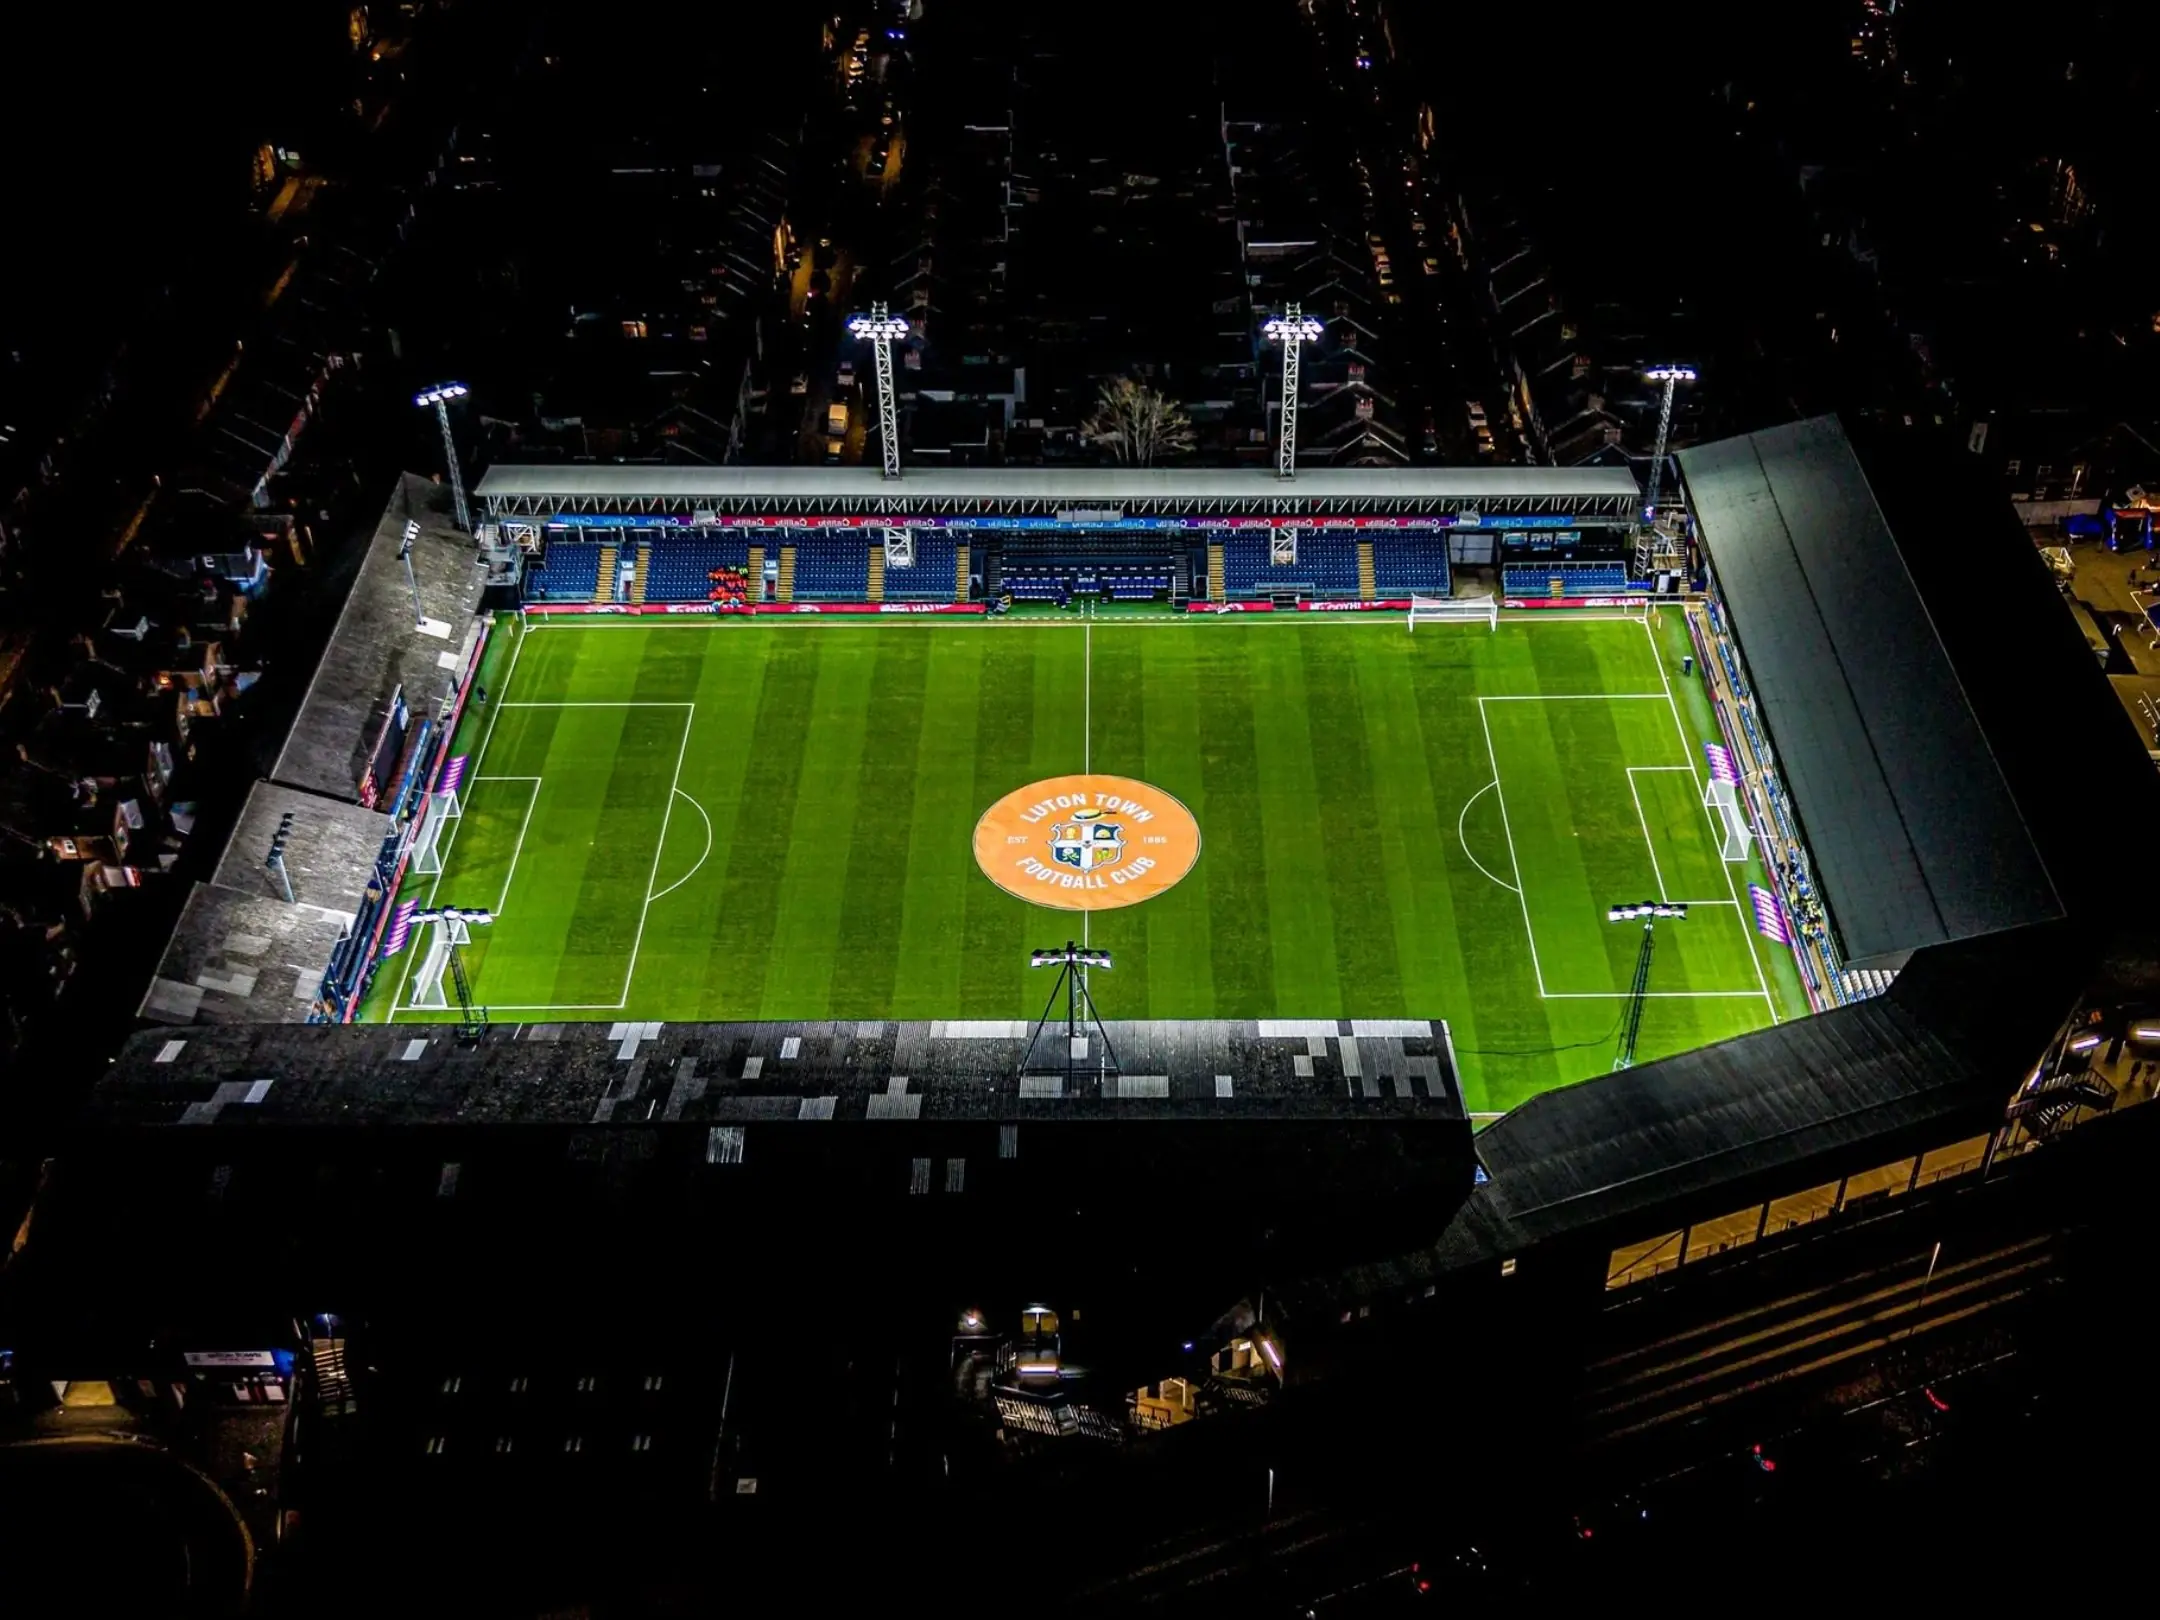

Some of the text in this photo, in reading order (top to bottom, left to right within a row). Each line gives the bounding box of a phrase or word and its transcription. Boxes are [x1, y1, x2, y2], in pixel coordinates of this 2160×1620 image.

[1019, 793, 1154, 824] LUTON TOWN
[1006, 836, 1028, 844] EST
[1016, 856, 1157, 889] FOOTBALL CLUB
